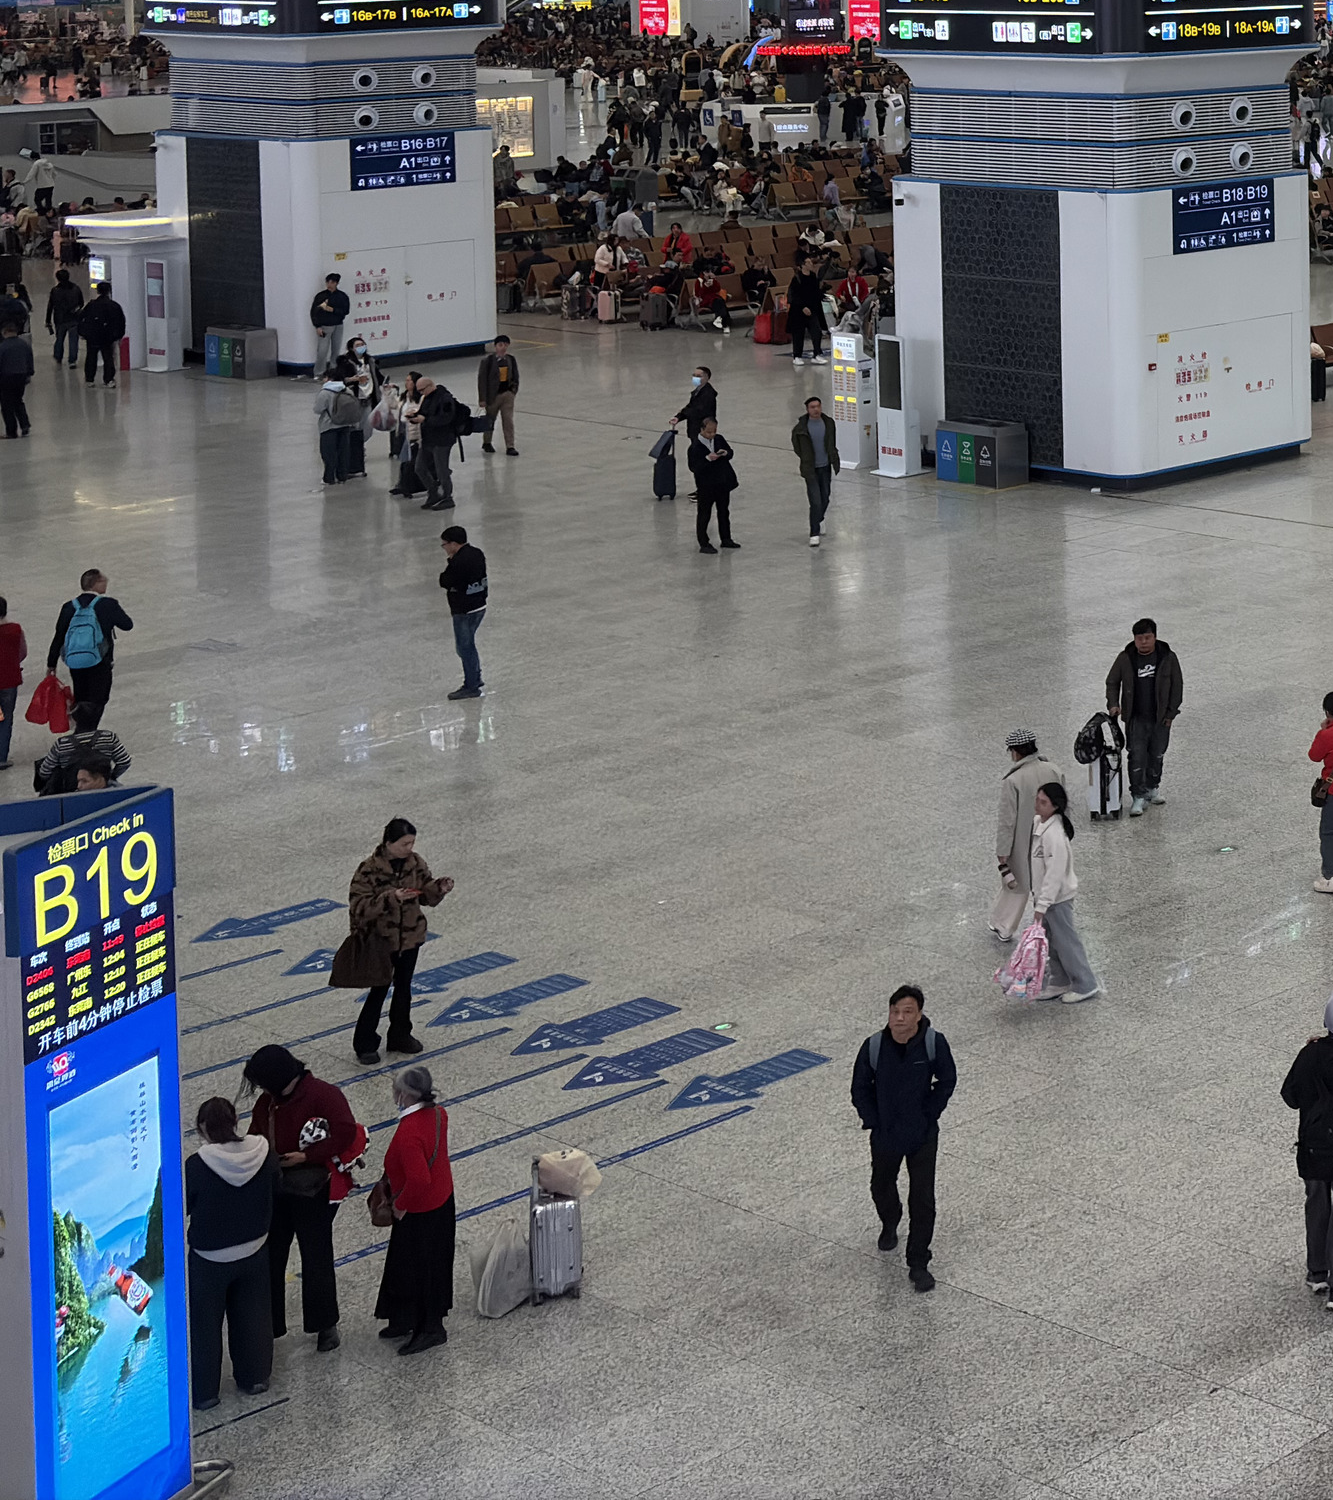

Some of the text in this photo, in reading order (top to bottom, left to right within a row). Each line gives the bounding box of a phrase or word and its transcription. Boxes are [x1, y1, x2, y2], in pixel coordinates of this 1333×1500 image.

[352, 8, 397, 22] 16B-17B
[410, 7, 453, 19] 16A-17A
[1178, 23, 1221, 37] 18B-19B
[1234, 20, 1275, 34] 18A-19A
[399, 157, 416, 169] A1
[1202, 190, 1220, 200] 检票口
[1220, 211, 1236, 225] A1
[47, 812, 144, 865] 检票口 Check in
[34, 831, 158, 948] B19
[140, 901, 158, 919] 状态
[103, 917, 121, 936] 开点
[65, 931, 91, 953] 终到站
[102, 934, 125, 951] 11:49
[30, 951, 48, 969] 车次
[103, 949, 126, 968] 12:04
[26, 965, 54, 986] D2406
[103, 965, 126, 984] 12:10
[26, 982, 55, 1003] G6568
[104, 981, 126, 1000] 12:20
[27, 998, 56, 1019] G2766
[38, 976, 164, 1055] 开车前4分钟停止检票
[28, 1014, 56, 1036] D2342
